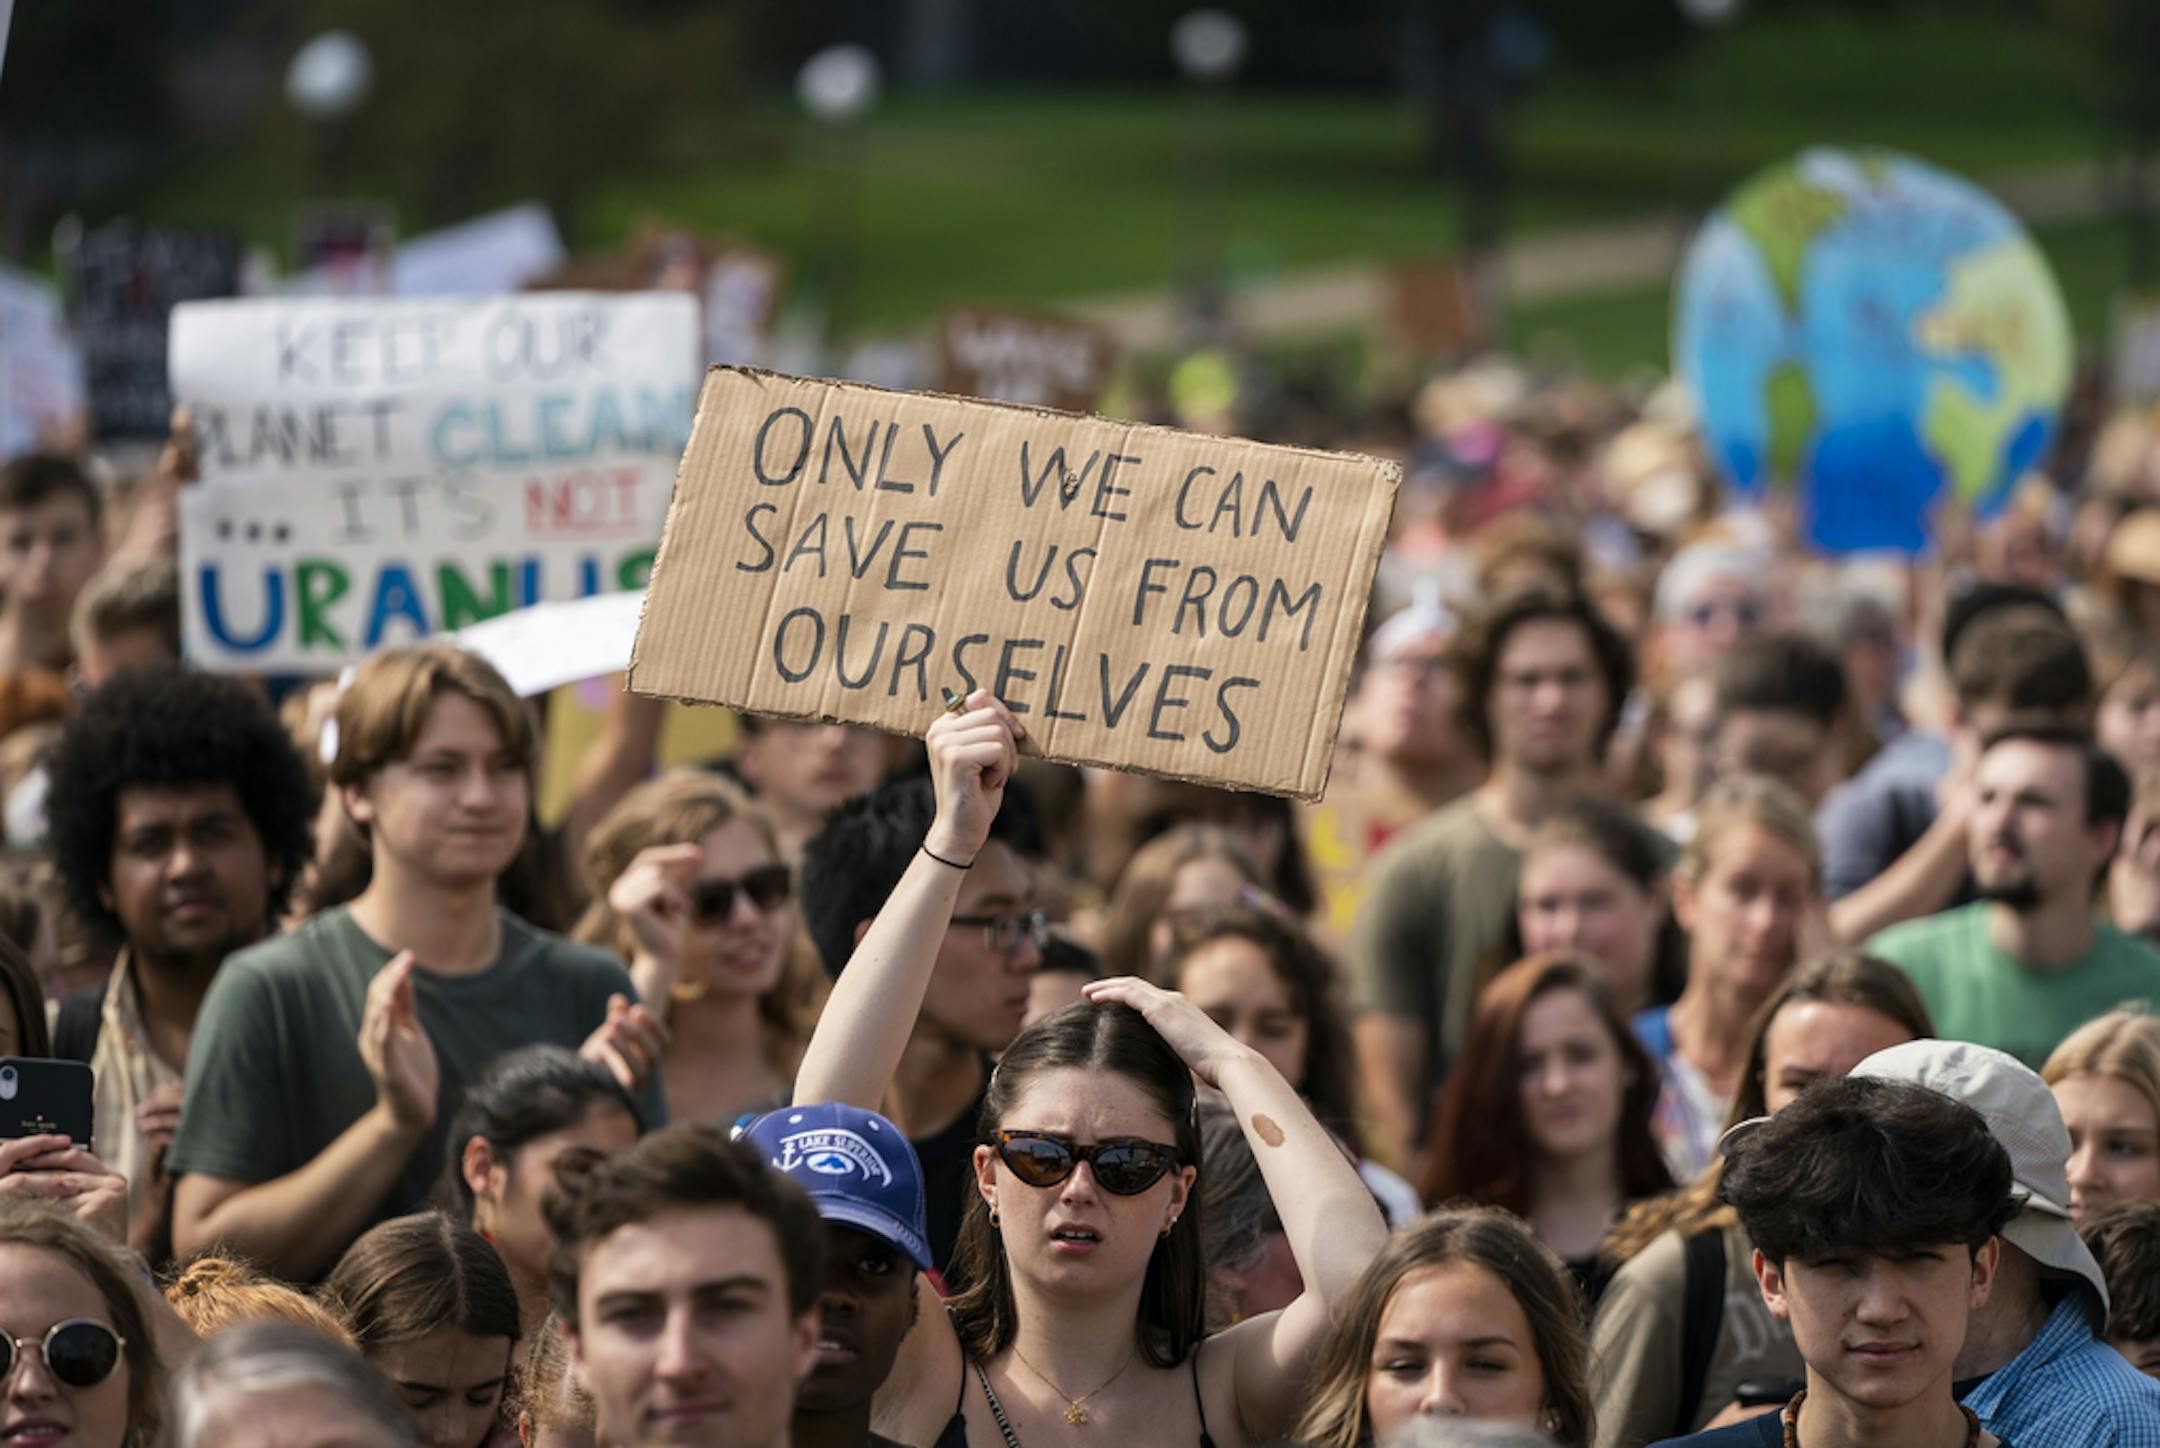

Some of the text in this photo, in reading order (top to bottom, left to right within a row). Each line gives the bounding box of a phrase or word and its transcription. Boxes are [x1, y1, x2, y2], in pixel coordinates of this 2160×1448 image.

[276, 298, 614, 388] KEEP OUR
[430, 386, 692, 474] CLEAN
[754, 406, 1314, 543] ONLY WE CAN
[526, 466, 643, 536] NOT
[736, 503, 1323, 651] SAVE US FROM
[773, 606, 1261, 754] OURSELVES
[799, 1134, 831, 1150] LAKE
